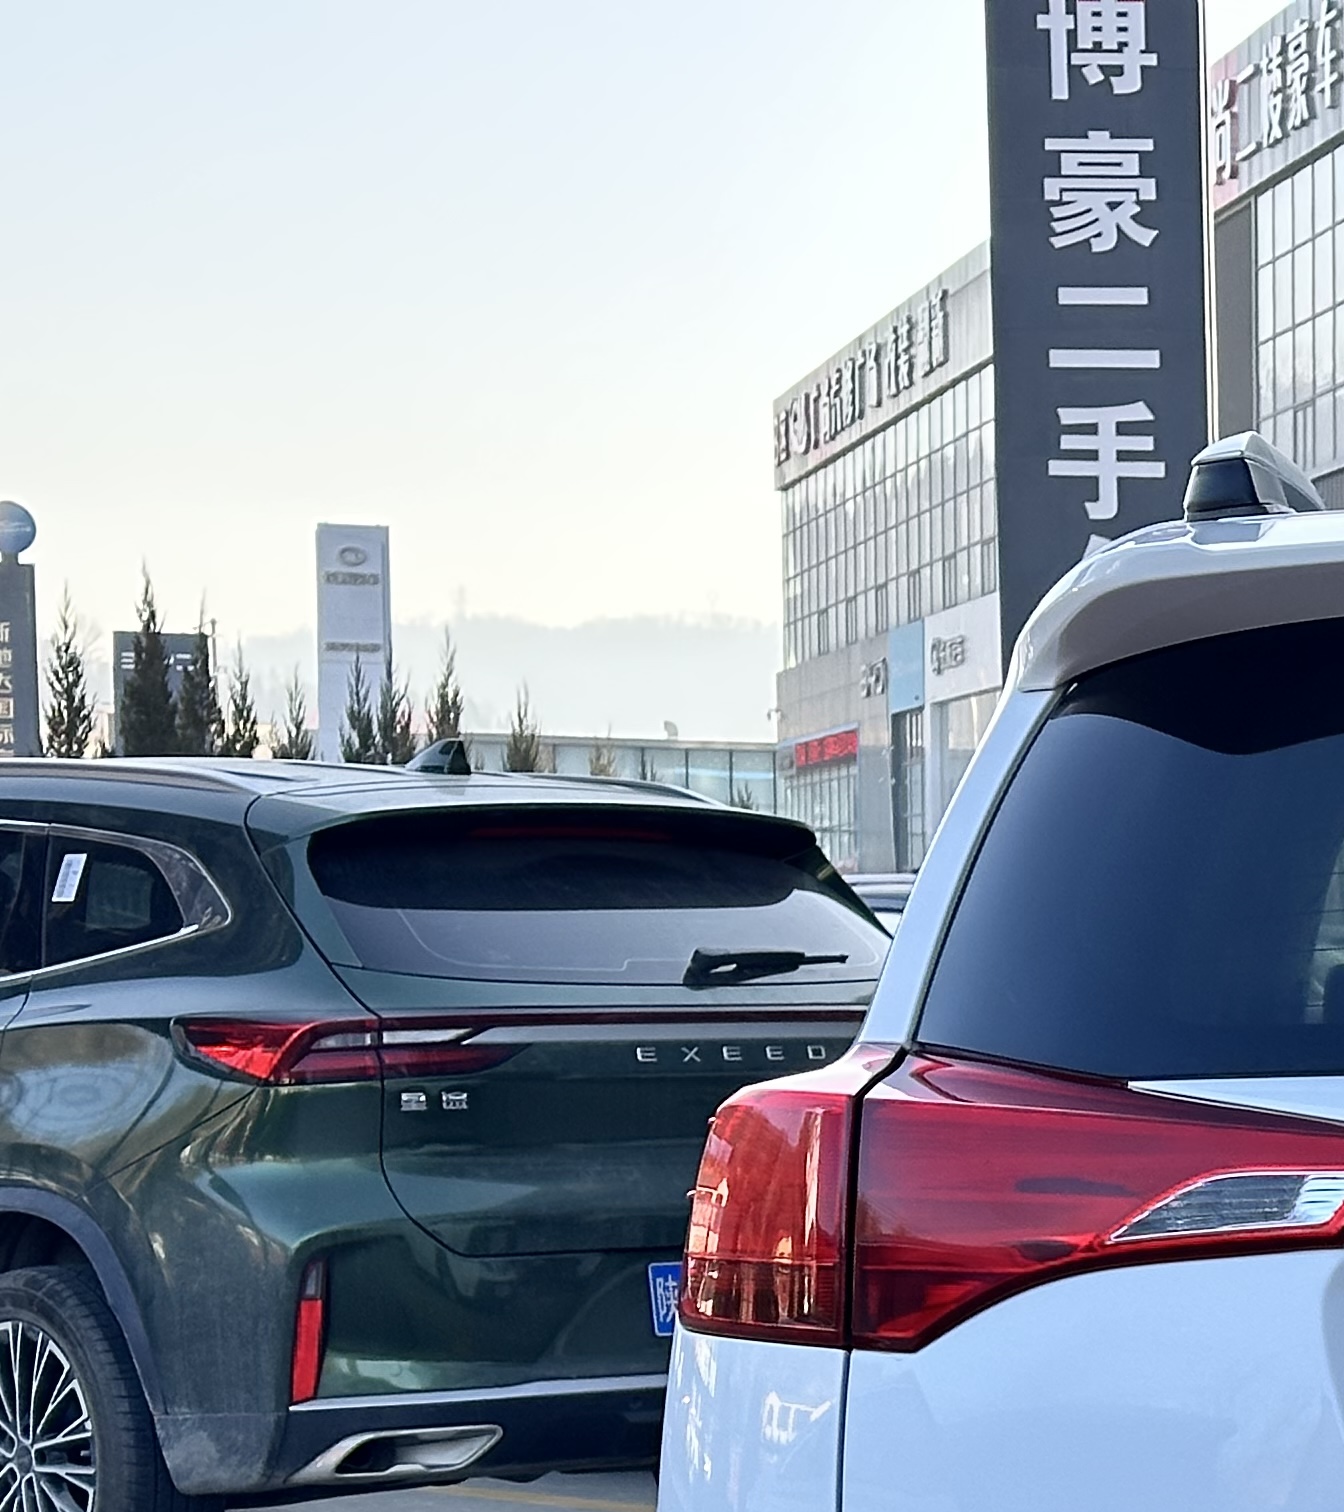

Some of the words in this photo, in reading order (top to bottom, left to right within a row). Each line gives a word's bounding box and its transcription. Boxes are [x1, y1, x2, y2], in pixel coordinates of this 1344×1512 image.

[1036, 0, 1166, 558] 博豪二手
[635, 1046, 827, 1062] EXEED
